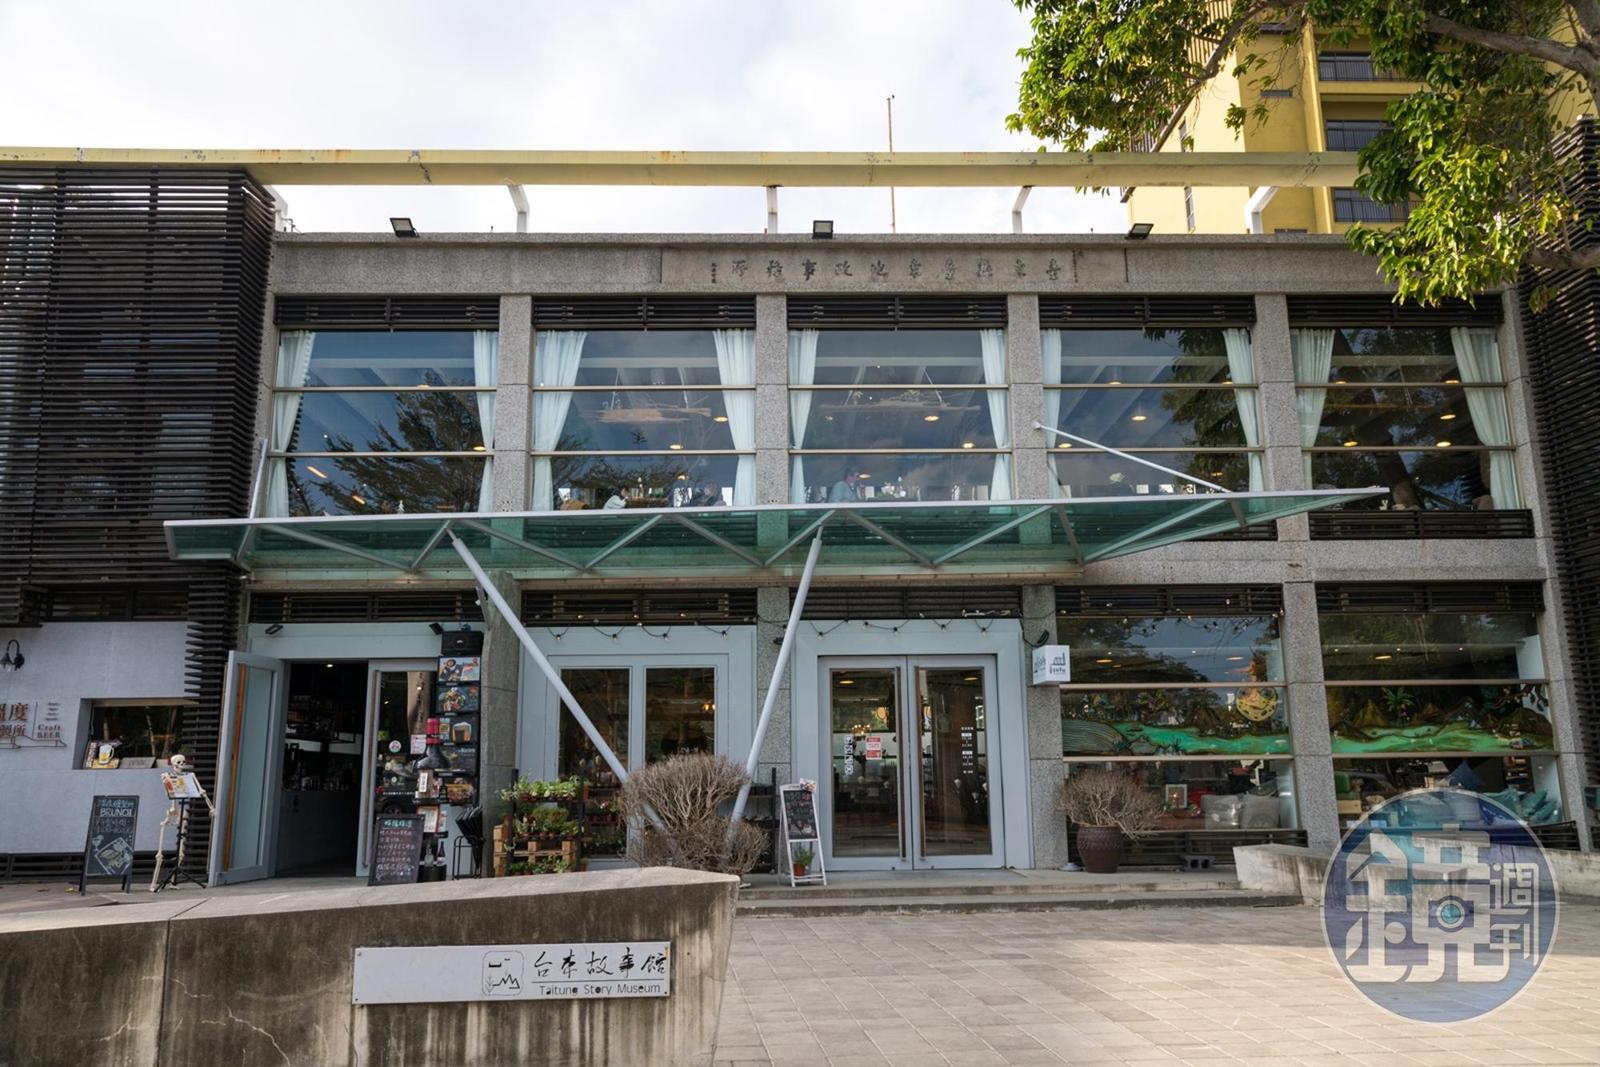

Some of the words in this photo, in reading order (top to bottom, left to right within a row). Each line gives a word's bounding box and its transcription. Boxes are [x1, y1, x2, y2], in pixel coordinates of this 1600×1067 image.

[540, 985, 578, 996] Taitung
[584, 984, 612, 995] Story
[617, 983, 660, 994] Museum
